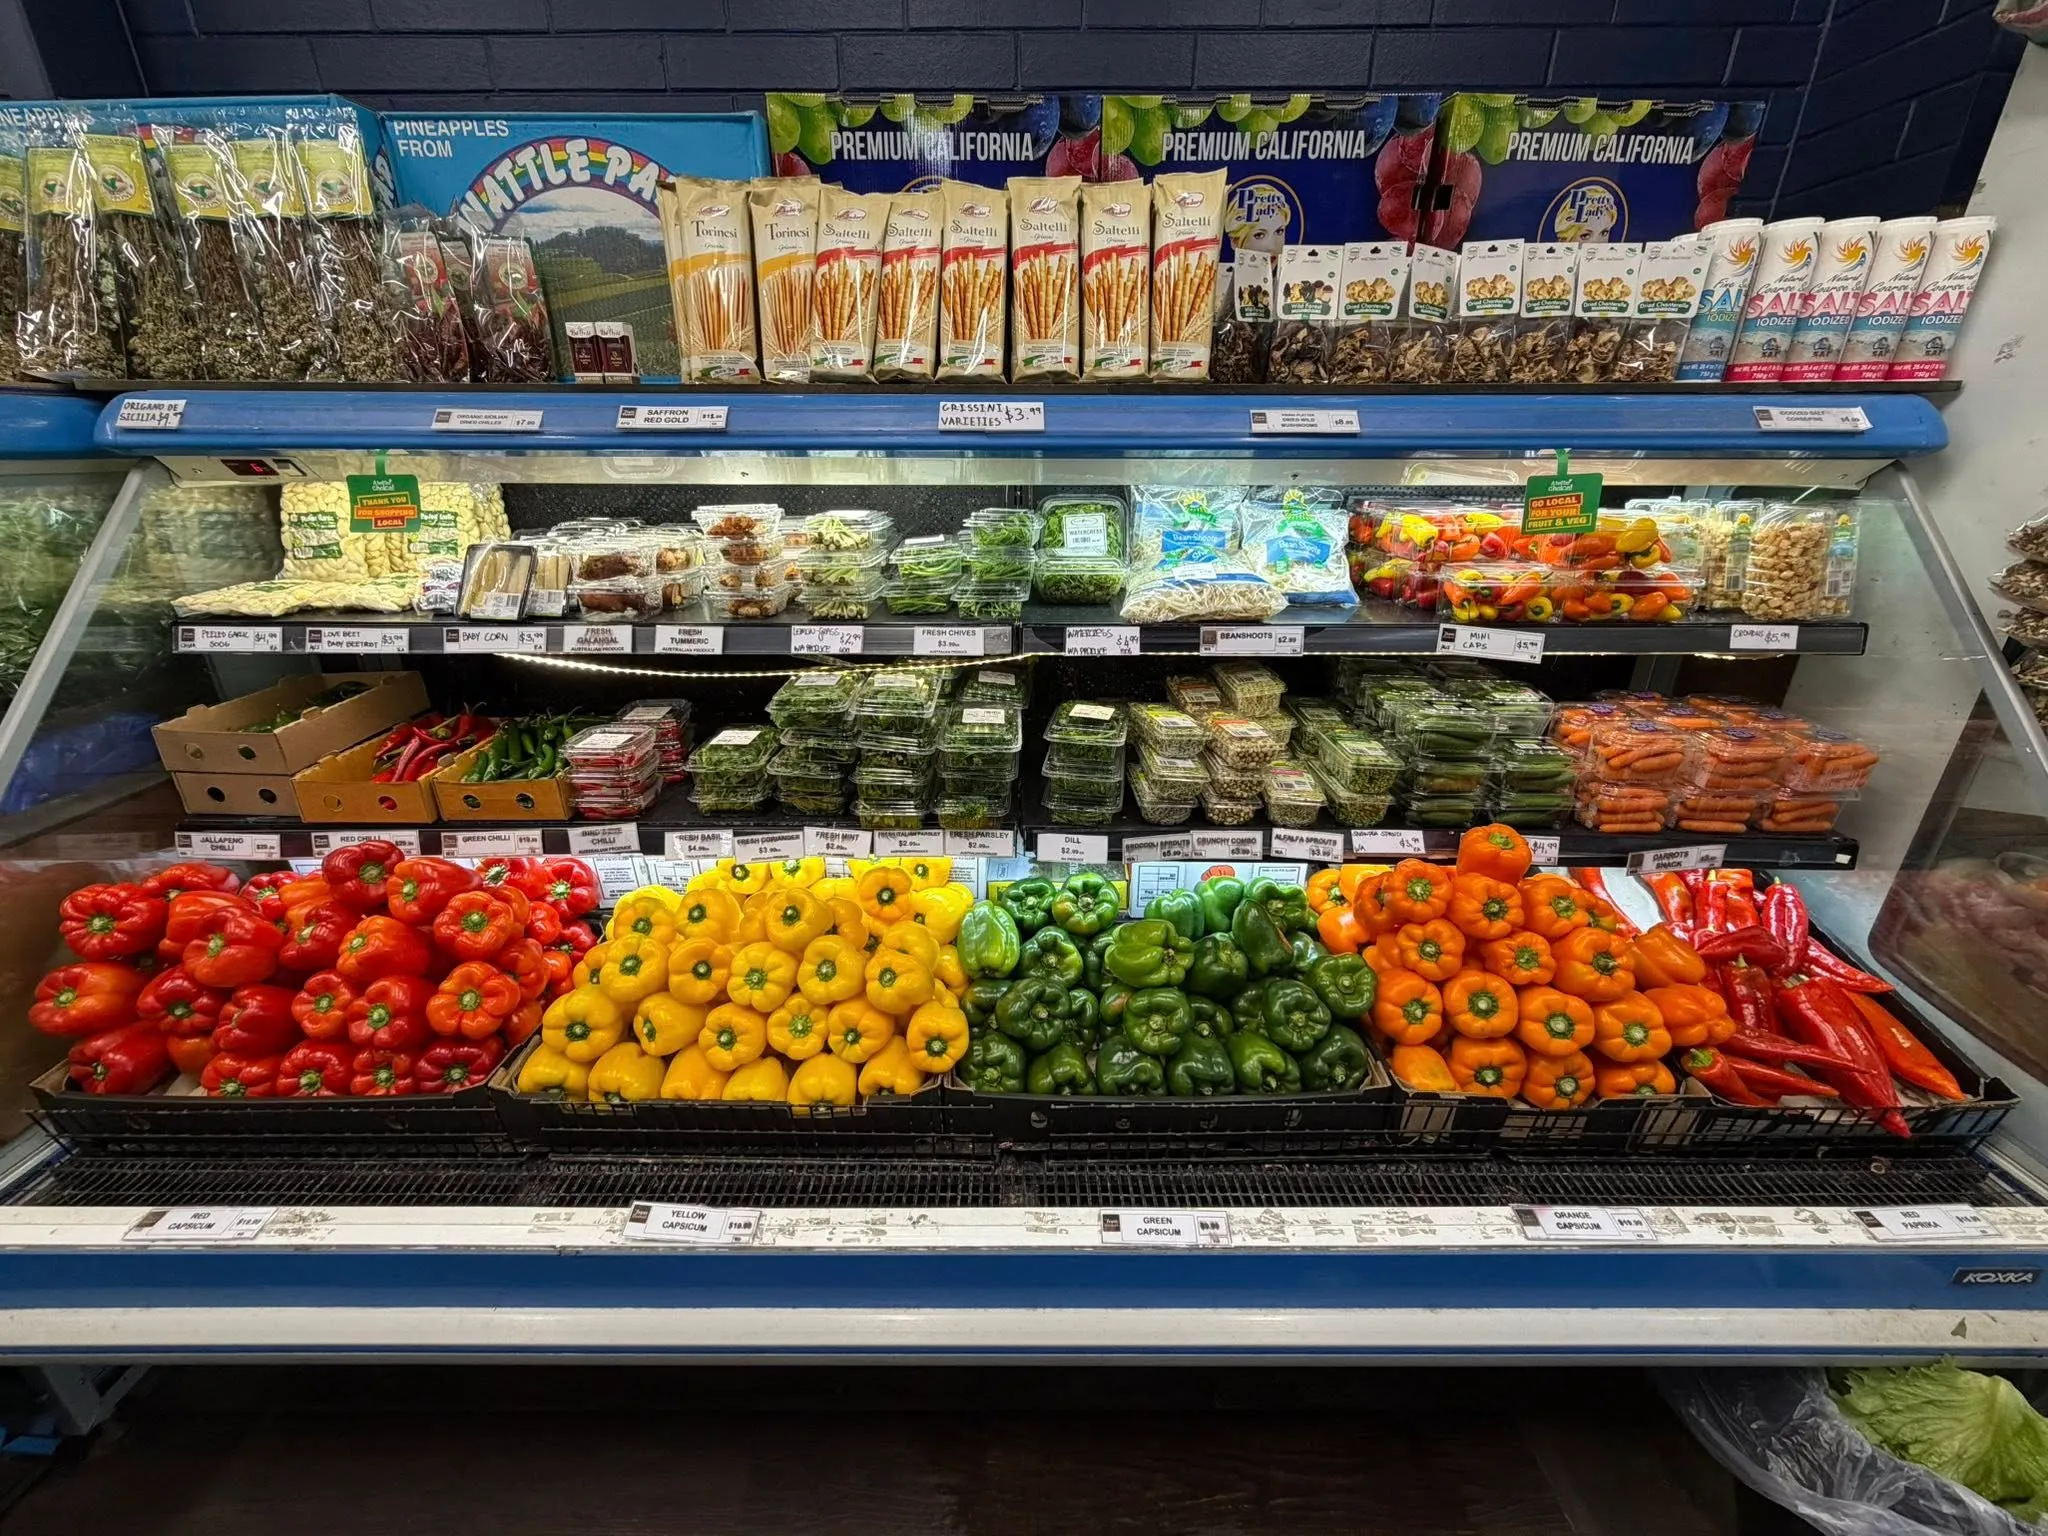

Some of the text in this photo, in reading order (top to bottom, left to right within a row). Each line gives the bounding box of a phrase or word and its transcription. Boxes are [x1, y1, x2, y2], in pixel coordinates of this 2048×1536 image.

[394, 120, 510, 137] PINEAPPLES
[397, 140, 453, 158] FROM
[830, 130, 1034, 162] PREMIUM CALIFORNIA
[1161, 129, 1366, 161] PREMIUM CALIFORNIA
[1505, 131, 1693, 164] PREMIUM CALIFORNIA
[1237, 188, 1284, 210] Pretty
[1570, 190, 1612, 210] Pretty
[1019, 217, 1068, 234] Saltelli
[1162, 211, 1212, 229] Saltelli
[691, 220, 738, 239] Torinesi
[765, 222, 810, 241] Torinesi
[823, 223, 871, 242] Saltelli
[887, 222, 933, 243] Saltelli
[950, 219, 998, 242] Saltelli
[1092, 219, 1141, 237] Saltelli
[1756, 283, 1795, 296] Coarse
[1809, 282, 1849, 295] Coarse
[1869, 281, 1907, 294] Coarse
[1922, 281, 1965, 294] Coarse
[124, 401, 179, 412] ORIGANO DE
[942, 403, 1003, 414] GRISSINI
[119, 411, 156, 422] SICILIA
[642, 416, 690, 424] RED GOLD
[940, 416, 1003, 427] VARIETIES
[362, 495, 407, 506] THANK YOU
[1531, 496, 1578, 508] GO LOCAL
[357, 508, 415, 517] FOR SHOPPING
[1530, 508, 1578, 518] FOR YOUR
[376, 518, 404, 528] LOCAL
[1527, 516, 1587, 529] FRUIT & VEG
[1278, 539, 1298, 549] Bean
[462, 631, 509, 643] BABY CORN
[586, 627, 612, 637] FRESH
[678, 628, 703, 637] FRESH
[922, 629, 977, 637] FRESH CHIVES
[1220, 631, 1274, 640] BEANSHOOTS
[1469, 631, 1491, 641] MINI
[327, 640, 344, 648] BABY
[576, 636, 620, 646] GALANGAL
[669, 636, 709, 646] TUMMERIC
[1462, 642, 1488, 651] CAPS
[200, 836, 244, 845] JALLAPENO
[461, 833, 511, 843] GREEN CHILLI
[700, 832, 723, 841] BASIL
[736, 832, 802, 846] FRESH CORIANDER
[815, 831, 860, 842] FRESH MINT
[949, 830, 1010, 840] FRESH PARSLEY
[1064, 835, 1083, 845] DILL
[1273, 832, 1338, 847] ALFALFA SPROUTS
[591, 836, 617, 846] CHILLI
[1125, 838, 1191, 852] BROCCOLI SPROUTS
[1196, 836, 1258, 847] CRUNCHY COMBO
[210, 844, 236, 852] CHILLI
[1652, 849, 1690, 862] CARROTS
[1655, 860, 1683, 870] SNACK
[190, 1211, 211, 1221] RED
[670, 1209, 708, 1221] YELLOW
[1554, 1210, 1593, 1220] ORANGE
[1899, 1210, 1921, 1219] RED
[167, 1221, 217, 1231] CAPSICUM
[661, 1220, 708, 1233] CAPSICUM
[1142, 1216, 1173, 1226] GREEN
[1556, 1221, 1603, 1231] CAPSICUM
[1901, 1221, 1943, 1231] PAPRIKA
[1136, 1227, 1182, 1237] CAPSICUM
[1962, 1272, 2034, 1284] KOXKA
